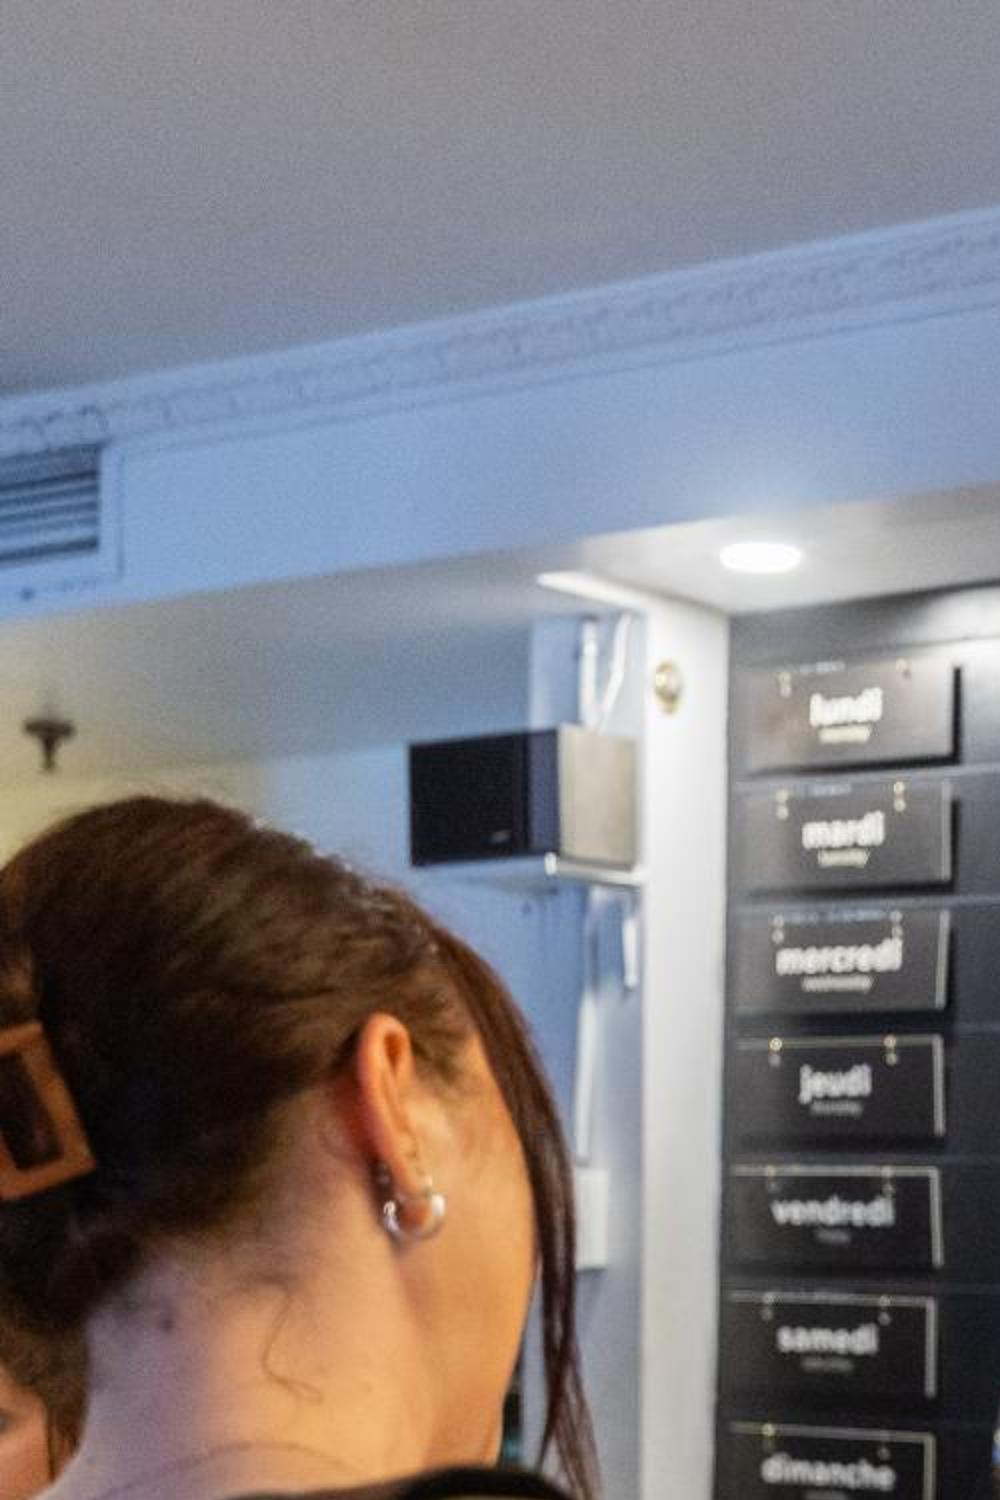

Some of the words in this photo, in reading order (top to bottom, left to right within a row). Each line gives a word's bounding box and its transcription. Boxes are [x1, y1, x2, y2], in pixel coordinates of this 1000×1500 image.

[810, 687, 883, 726] lundi
[802, 810, 885, 849] mardi
[776, 937, 902, 975] mercredi
[799, 1062, 873, 1104] jeudi
[770, 1196, 896, 1227] vendredi
[776, 1323, 879, 1355] samedi
[760, 1451, 898, 1492] dimanche
